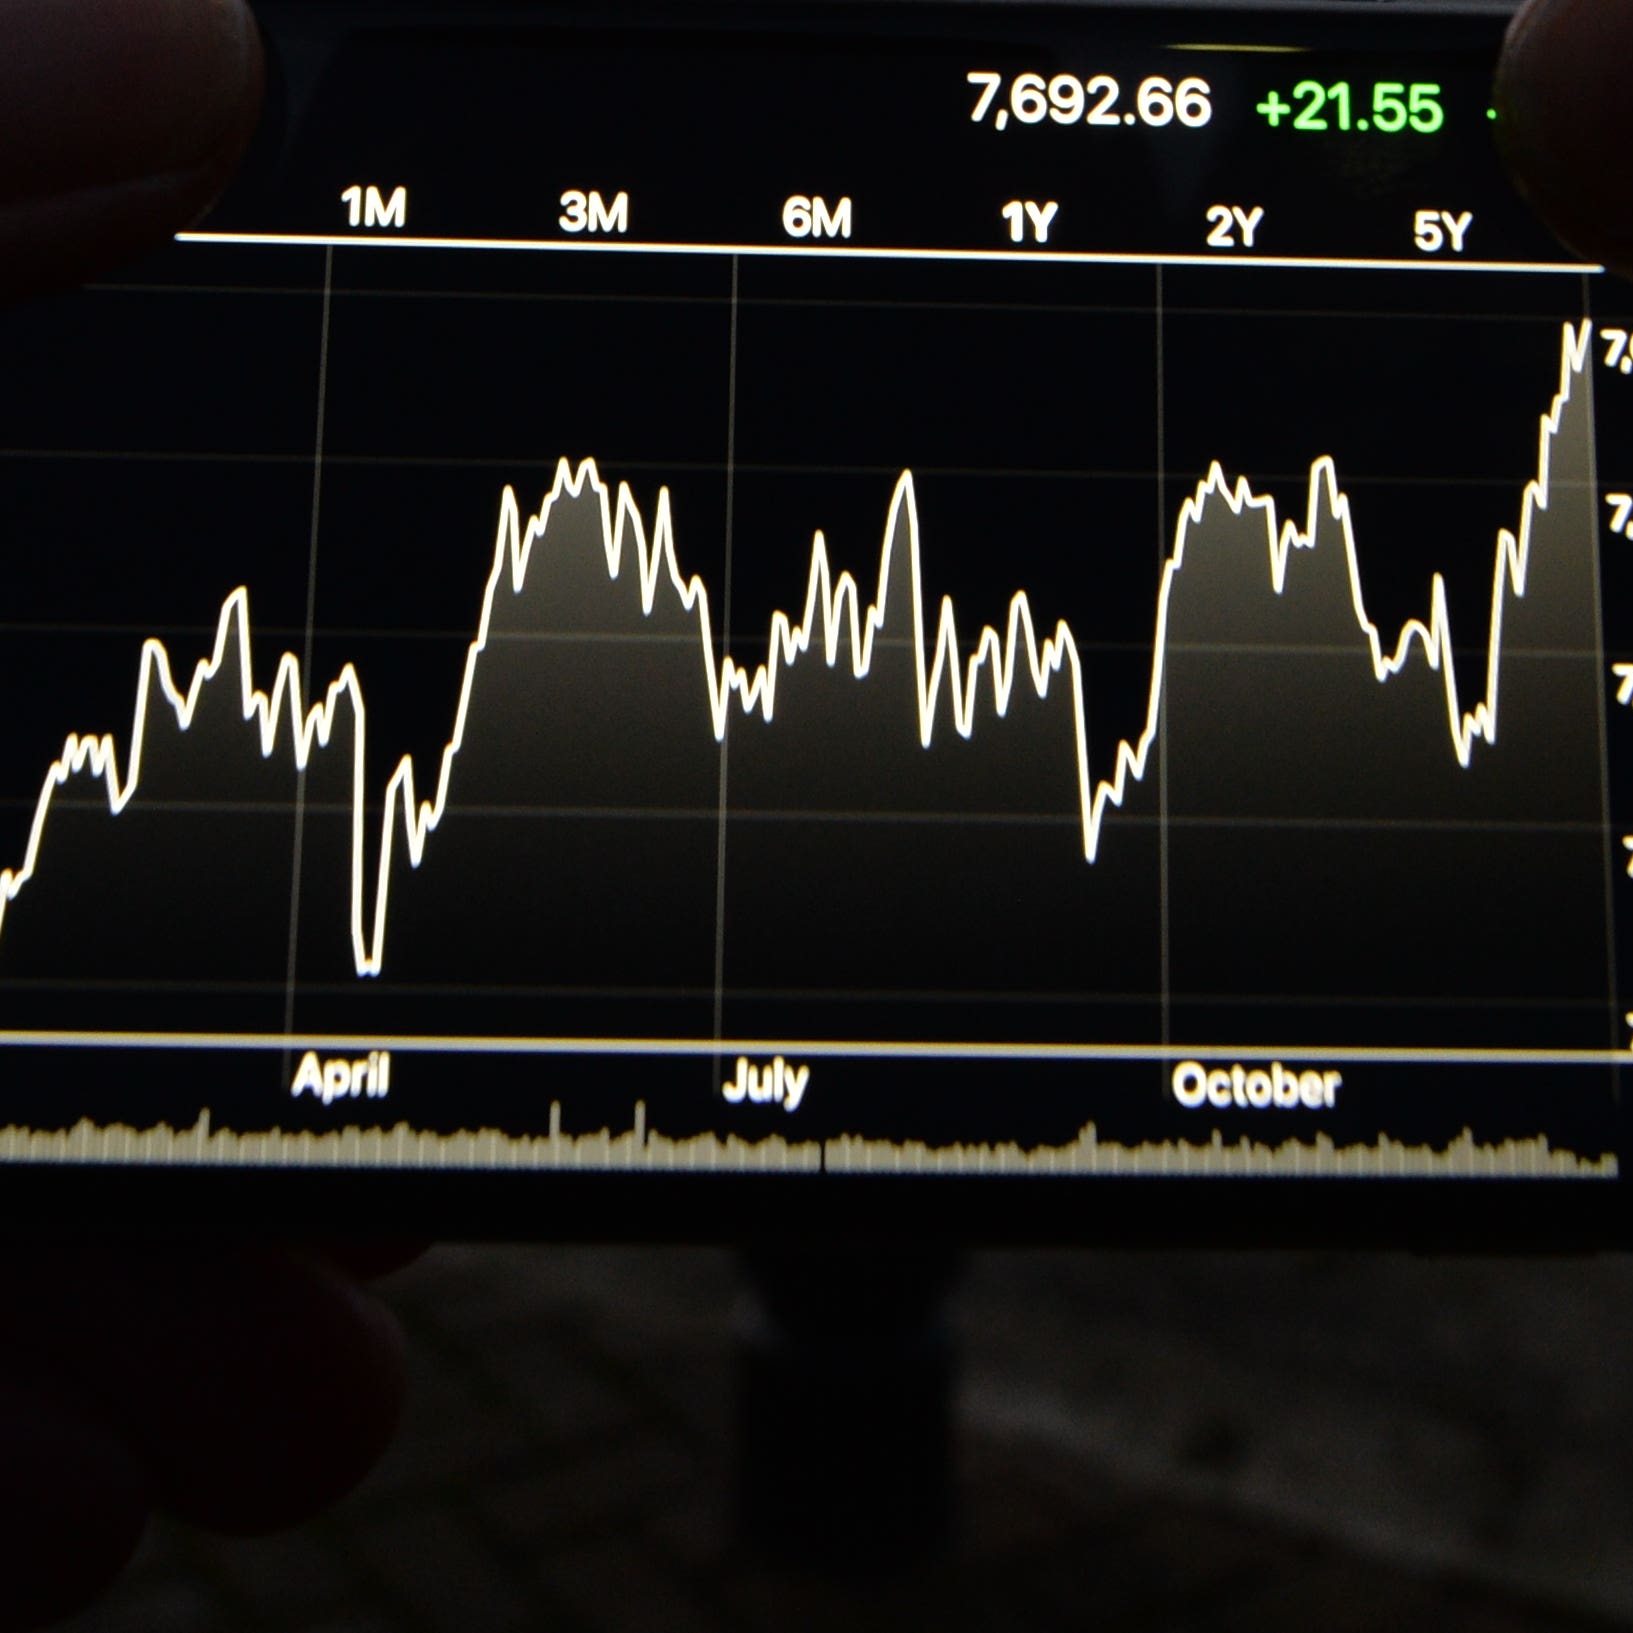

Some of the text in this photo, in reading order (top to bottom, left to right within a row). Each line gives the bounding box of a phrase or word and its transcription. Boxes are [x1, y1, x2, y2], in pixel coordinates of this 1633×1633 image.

[965, 70, 1445, 135] 7,692.66 +21.55
[339, 183, 1474, 252] 1M 3M 6M 1Y 2Y 5Y
[290, 1051, 1343, 1112] April July October
